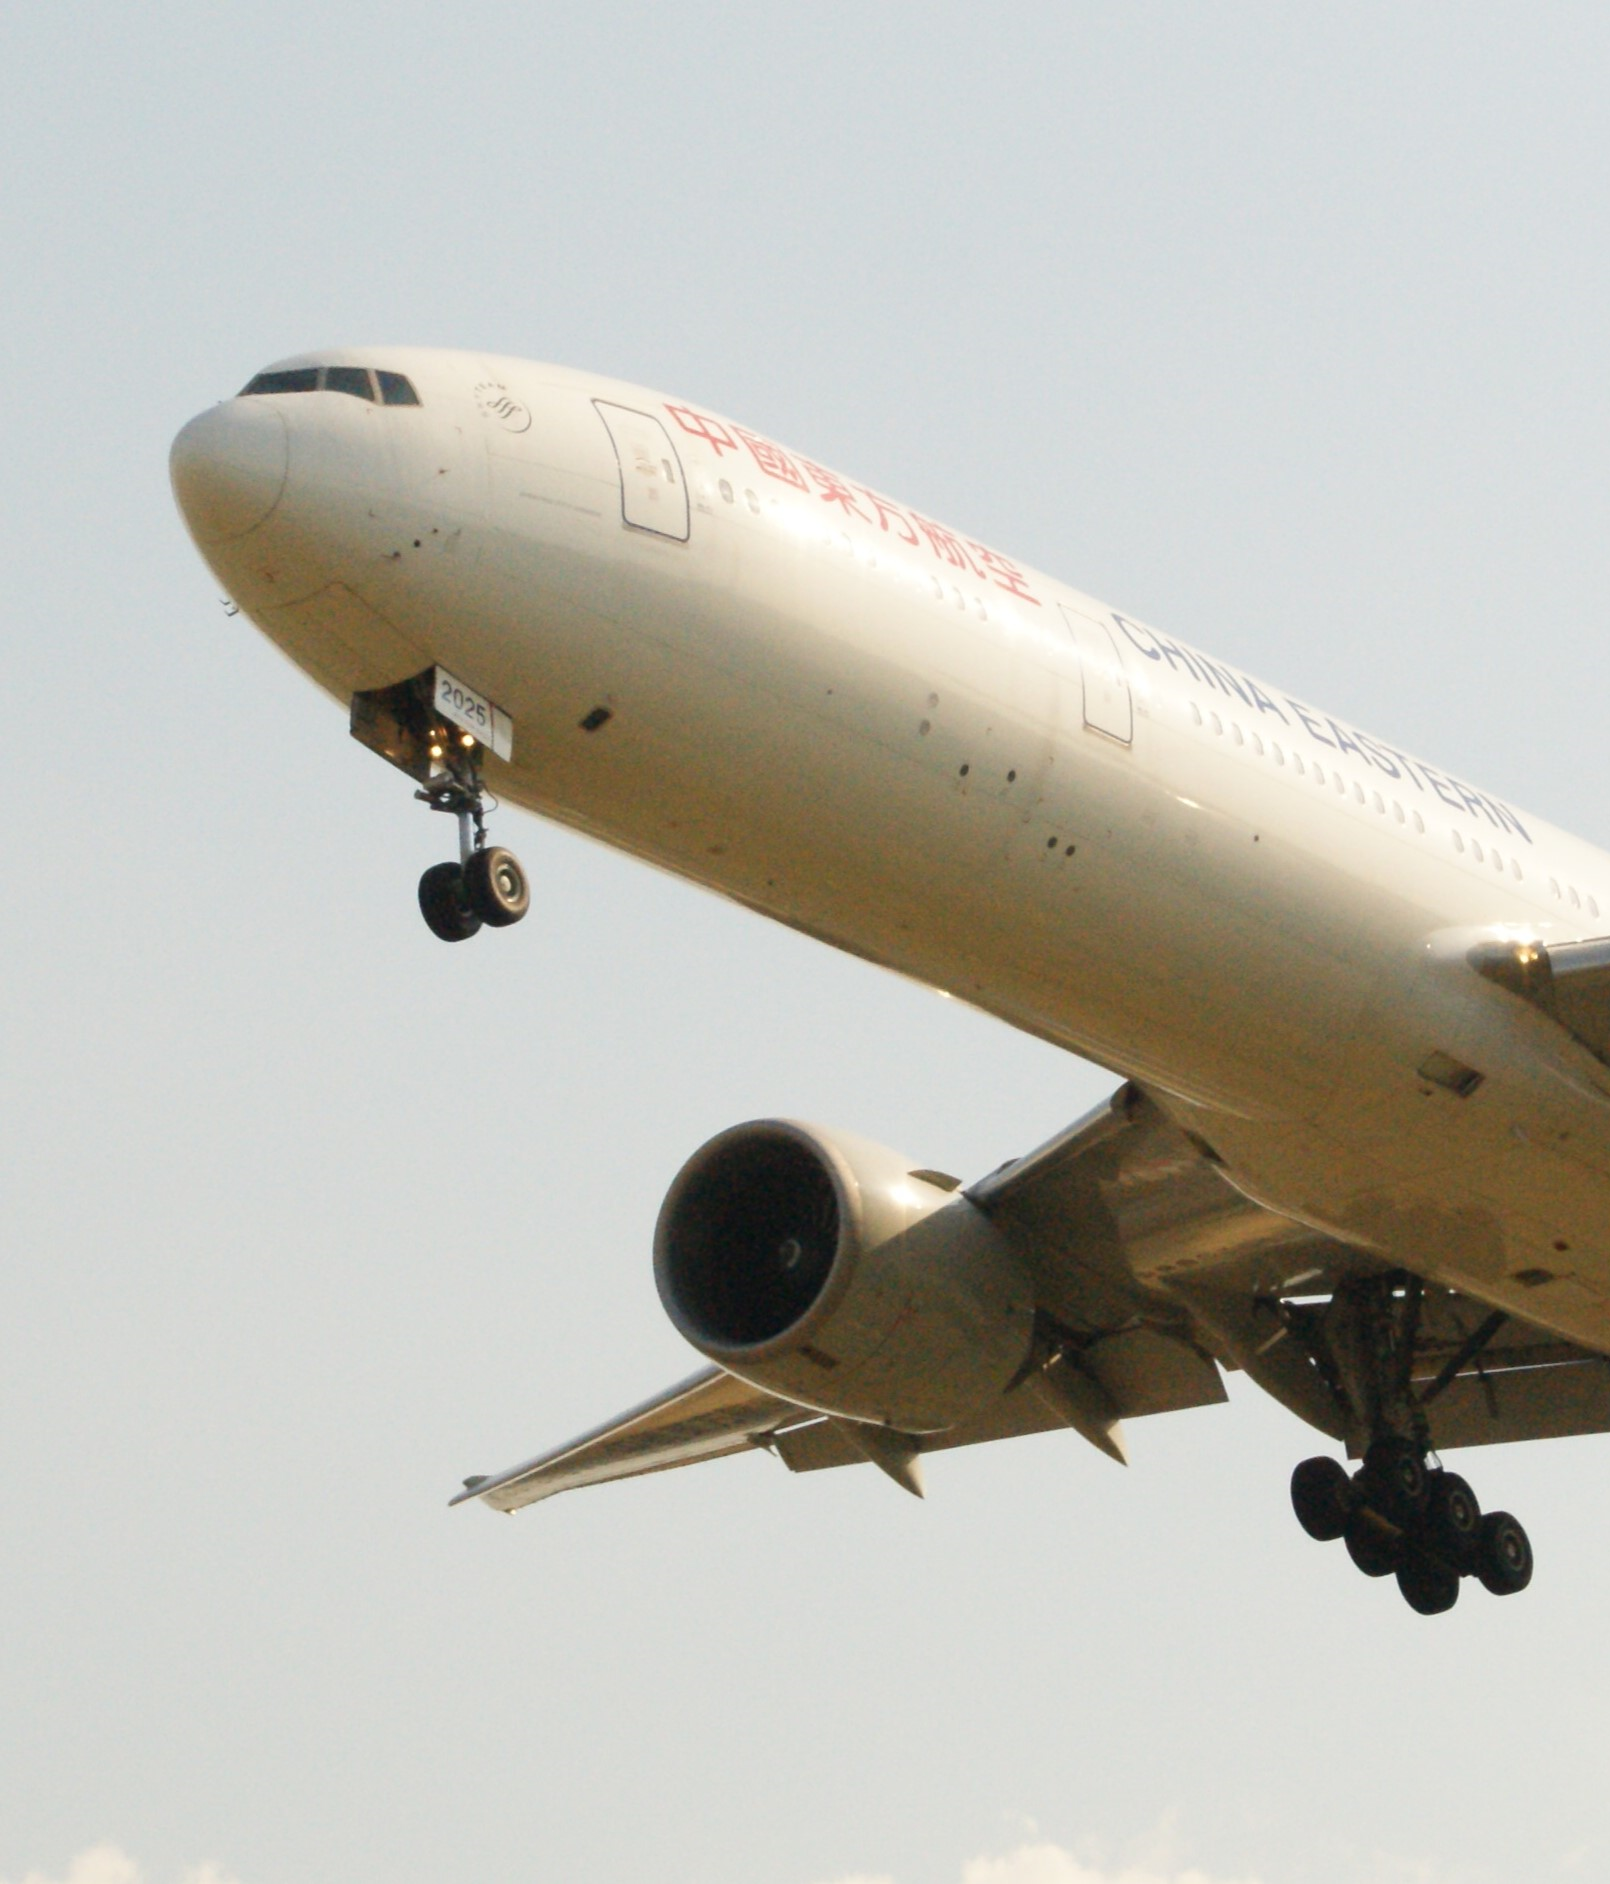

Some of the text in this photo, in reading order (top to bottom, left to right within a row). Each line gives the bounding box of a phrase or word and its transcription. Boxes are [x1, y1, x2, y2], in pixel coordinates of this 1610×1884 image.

[441, 680, 486, 726] 2025
[1111, 613, 1533, 844] CHINA EASTERN
